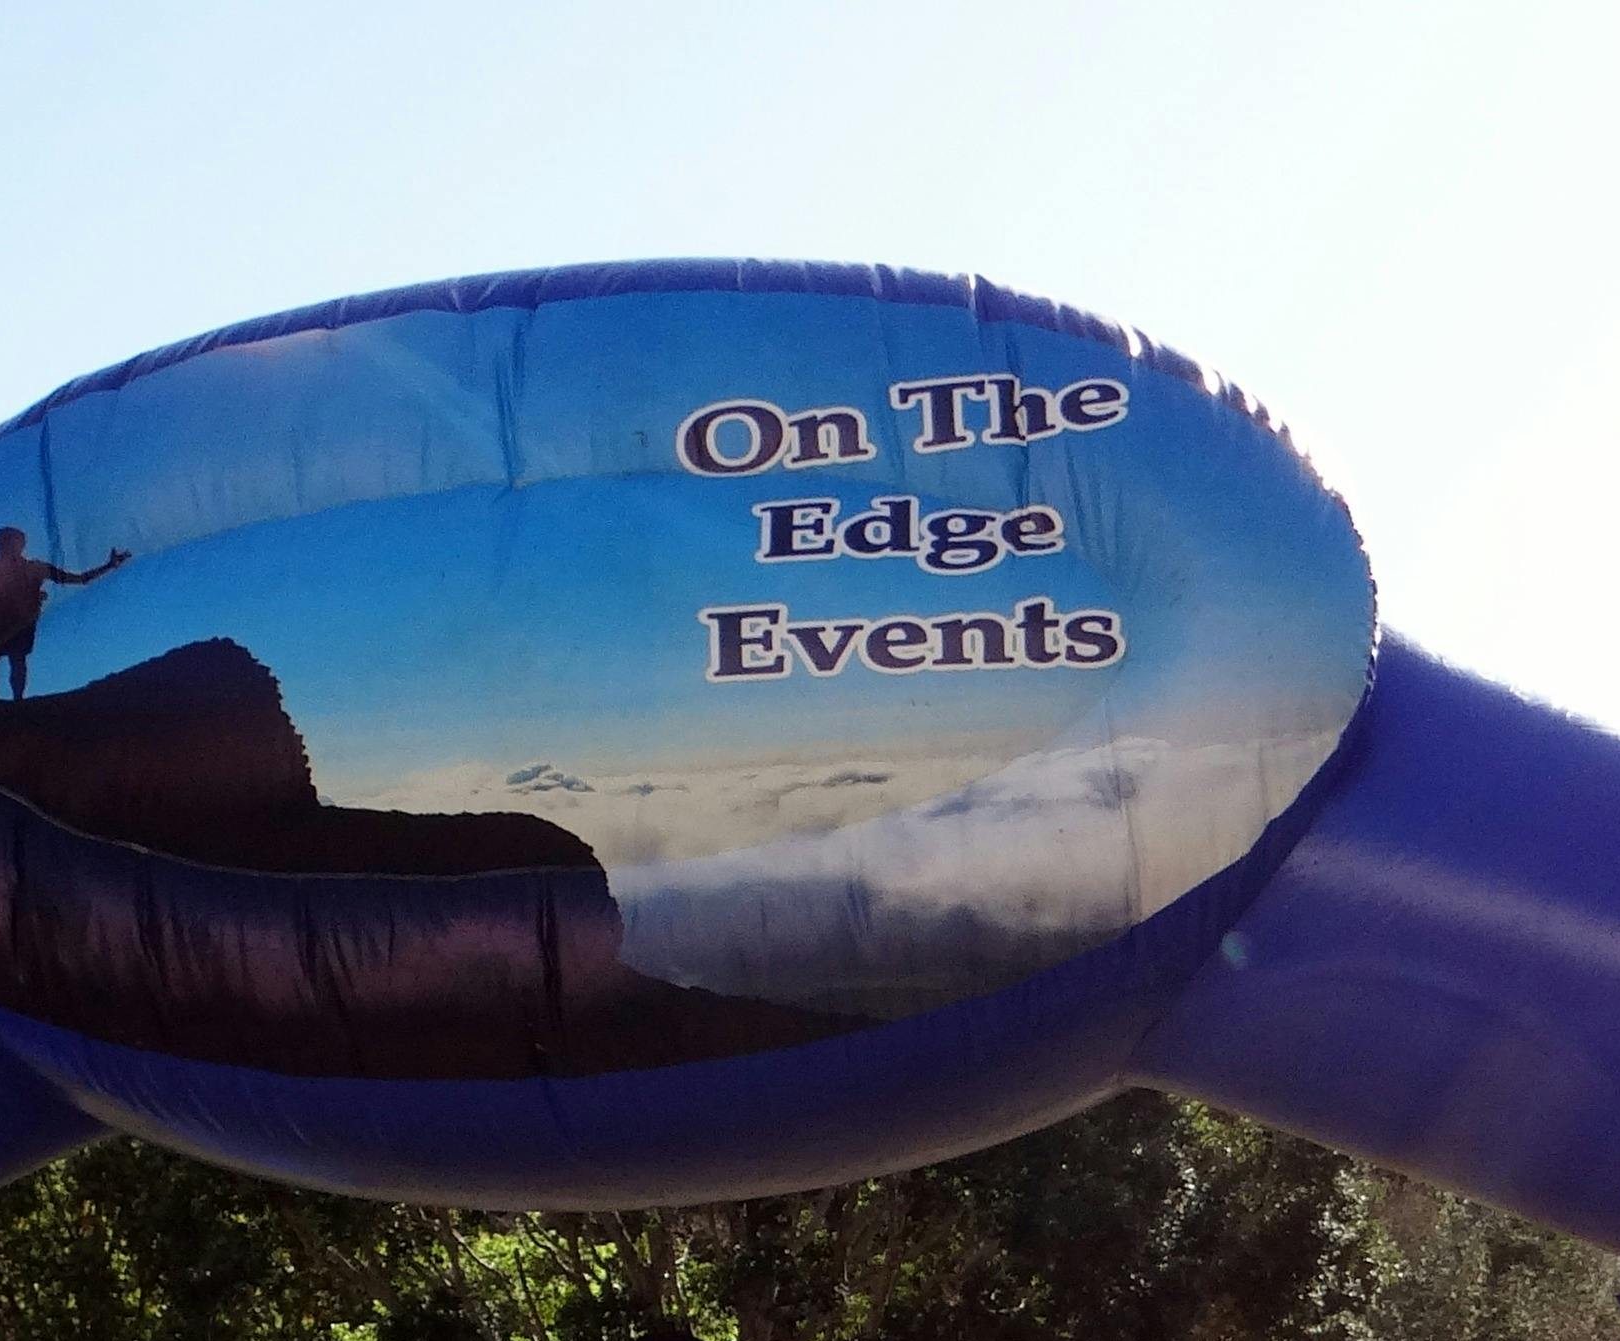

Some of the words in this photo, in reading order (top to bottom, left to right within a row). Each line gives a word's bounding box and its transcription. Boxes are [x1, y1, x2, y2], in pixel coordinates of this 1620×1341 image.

[677, 400, 876, 477] On
[891, 373, 1129, 453] The
[753, 496, 1064, 575] Edge
[699, 596, 1126, 682] Events
